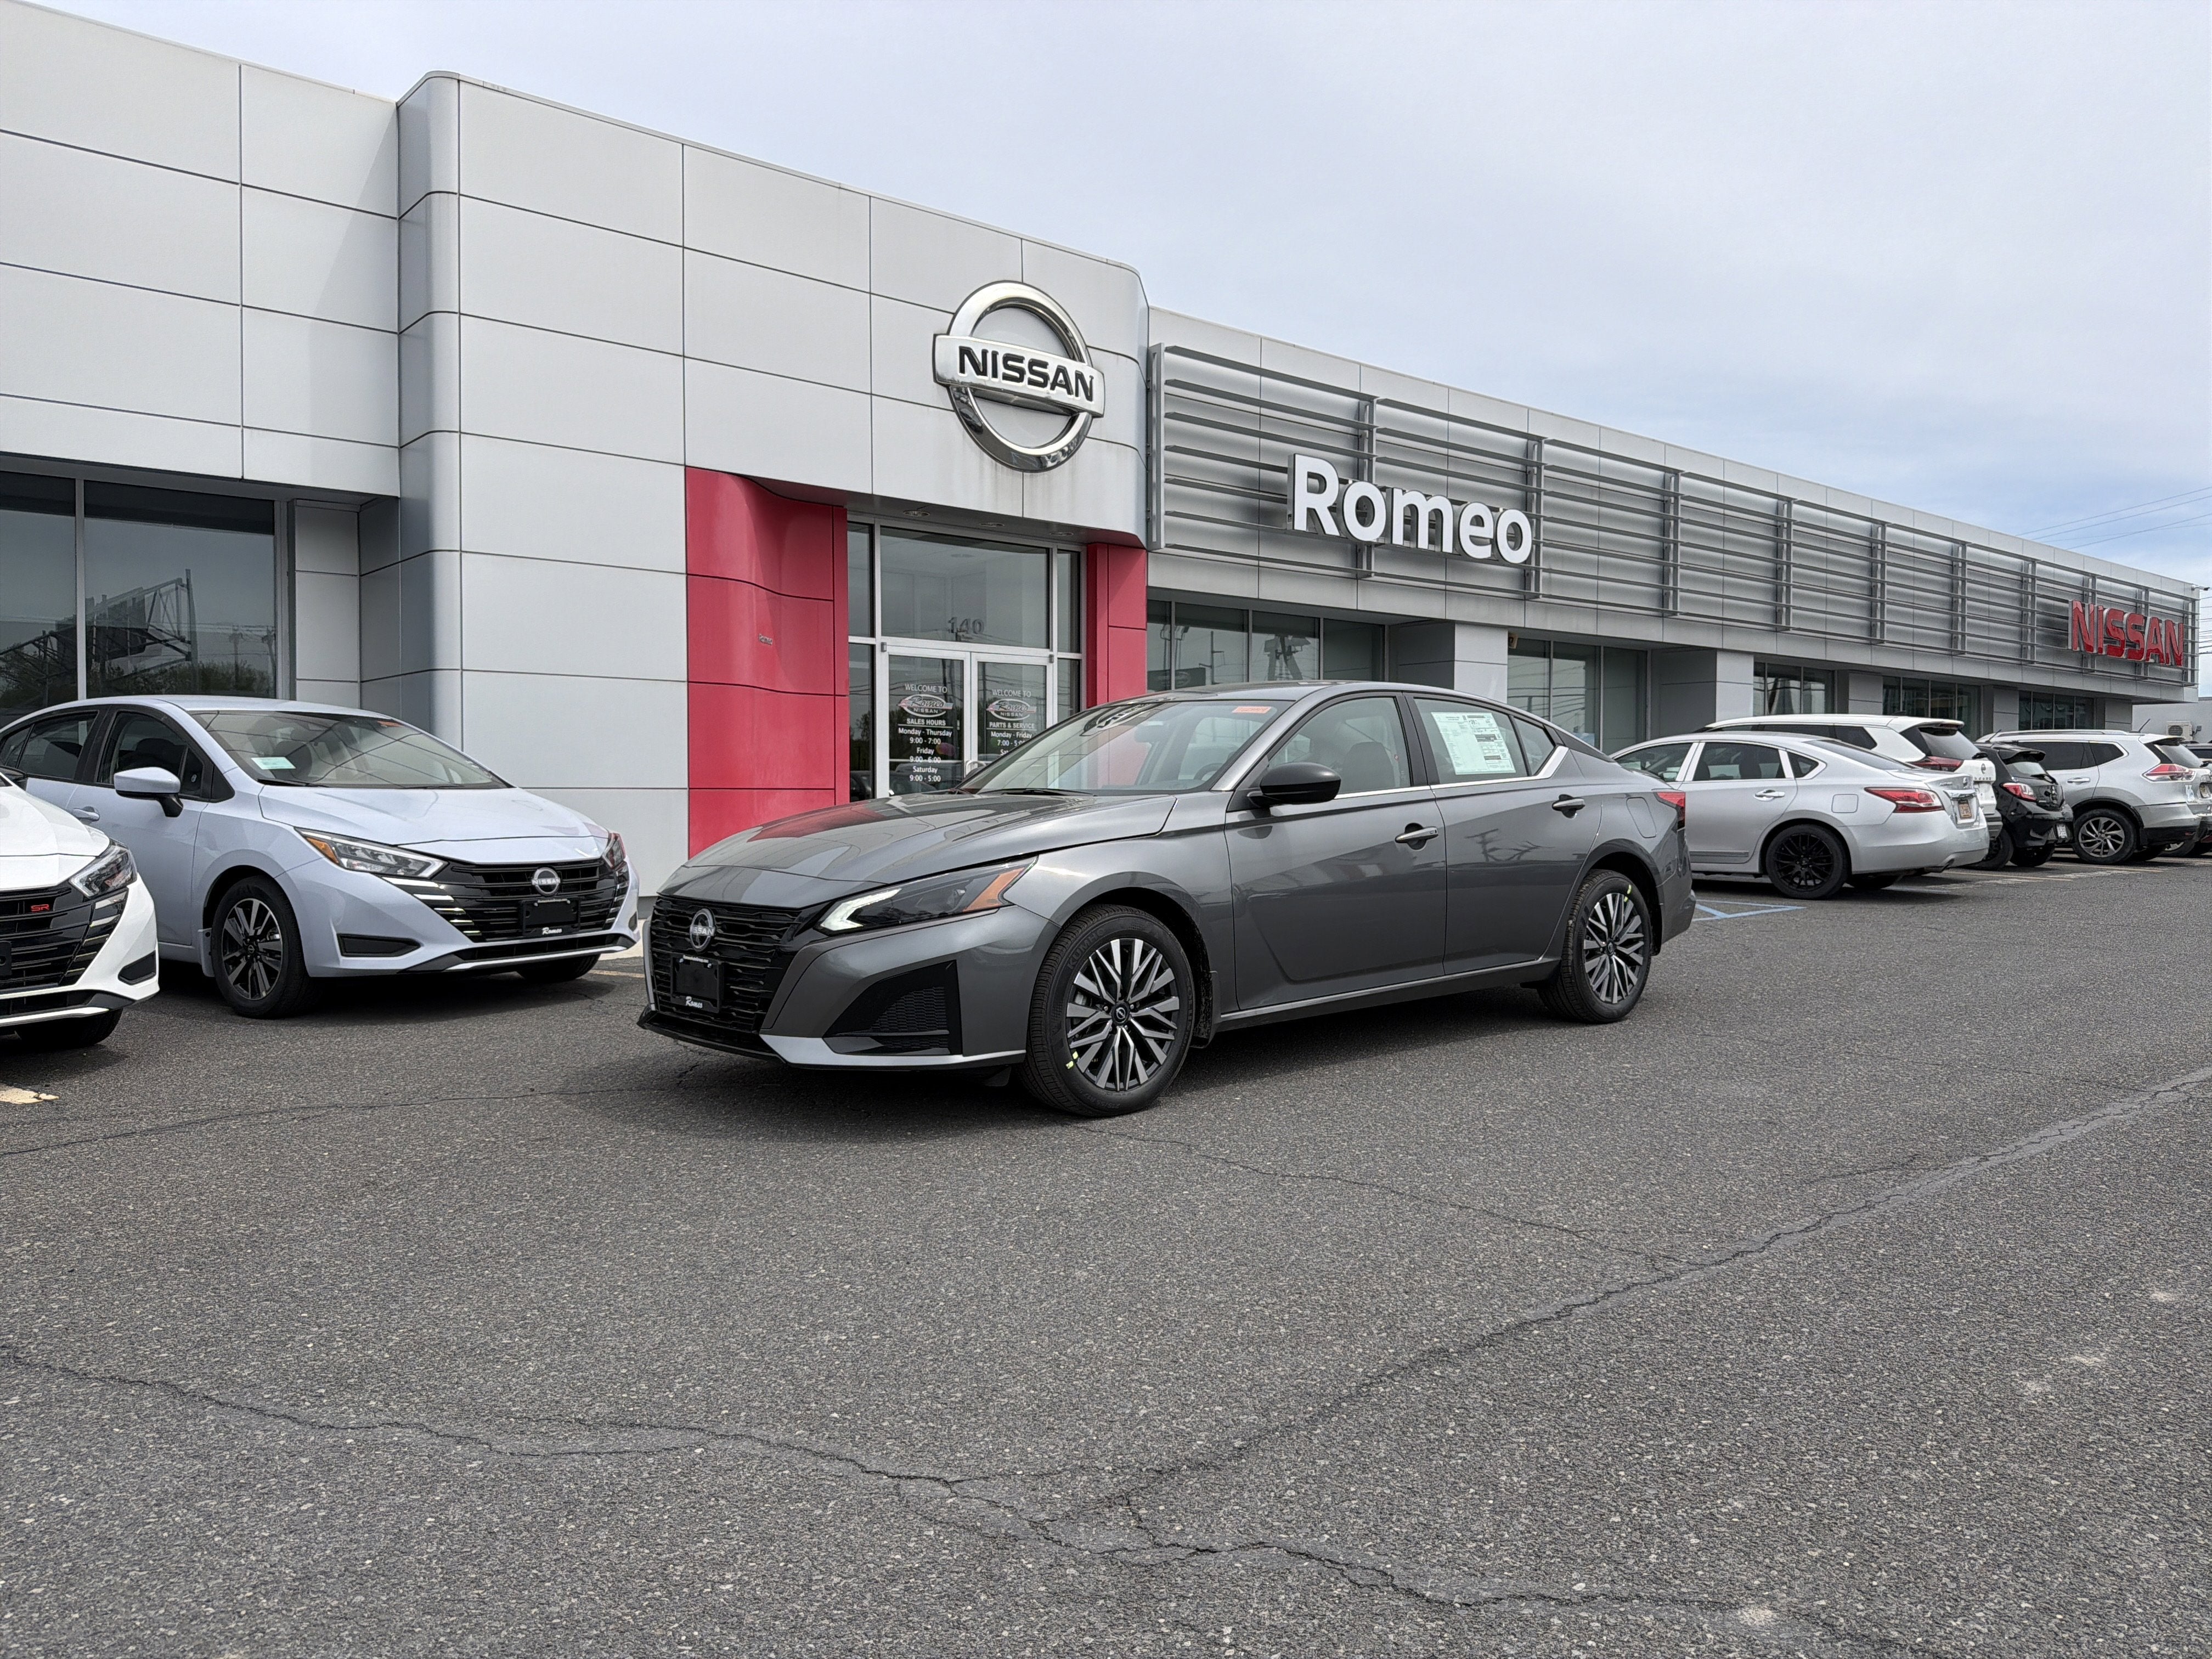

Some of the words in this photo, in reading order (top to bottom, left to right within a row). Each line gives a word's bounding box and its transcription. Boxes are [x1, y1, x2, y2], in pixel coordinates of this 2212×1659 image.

[958, 346, 1094, 403] NISSAN
[1289, 453, 1532, 564] Romeo
[947, 617, 985, 635] 140
[2069, 599, 2185, 667] NISSAN
[905, 684, 937, 693] WELCOME
[992, 689, 1022, 697] WELCOME
[910, 695, 944, 708] Romeo
[898, 727, 922, 736] Monday
[926, 729, 952, 737] Thursday
[917, 747, 934, 755] Friday
[912, 766, 938, 774] Saturday
[30, 904, 50, 912] SR
[1066, 928, 1105, 969] KUMHO
